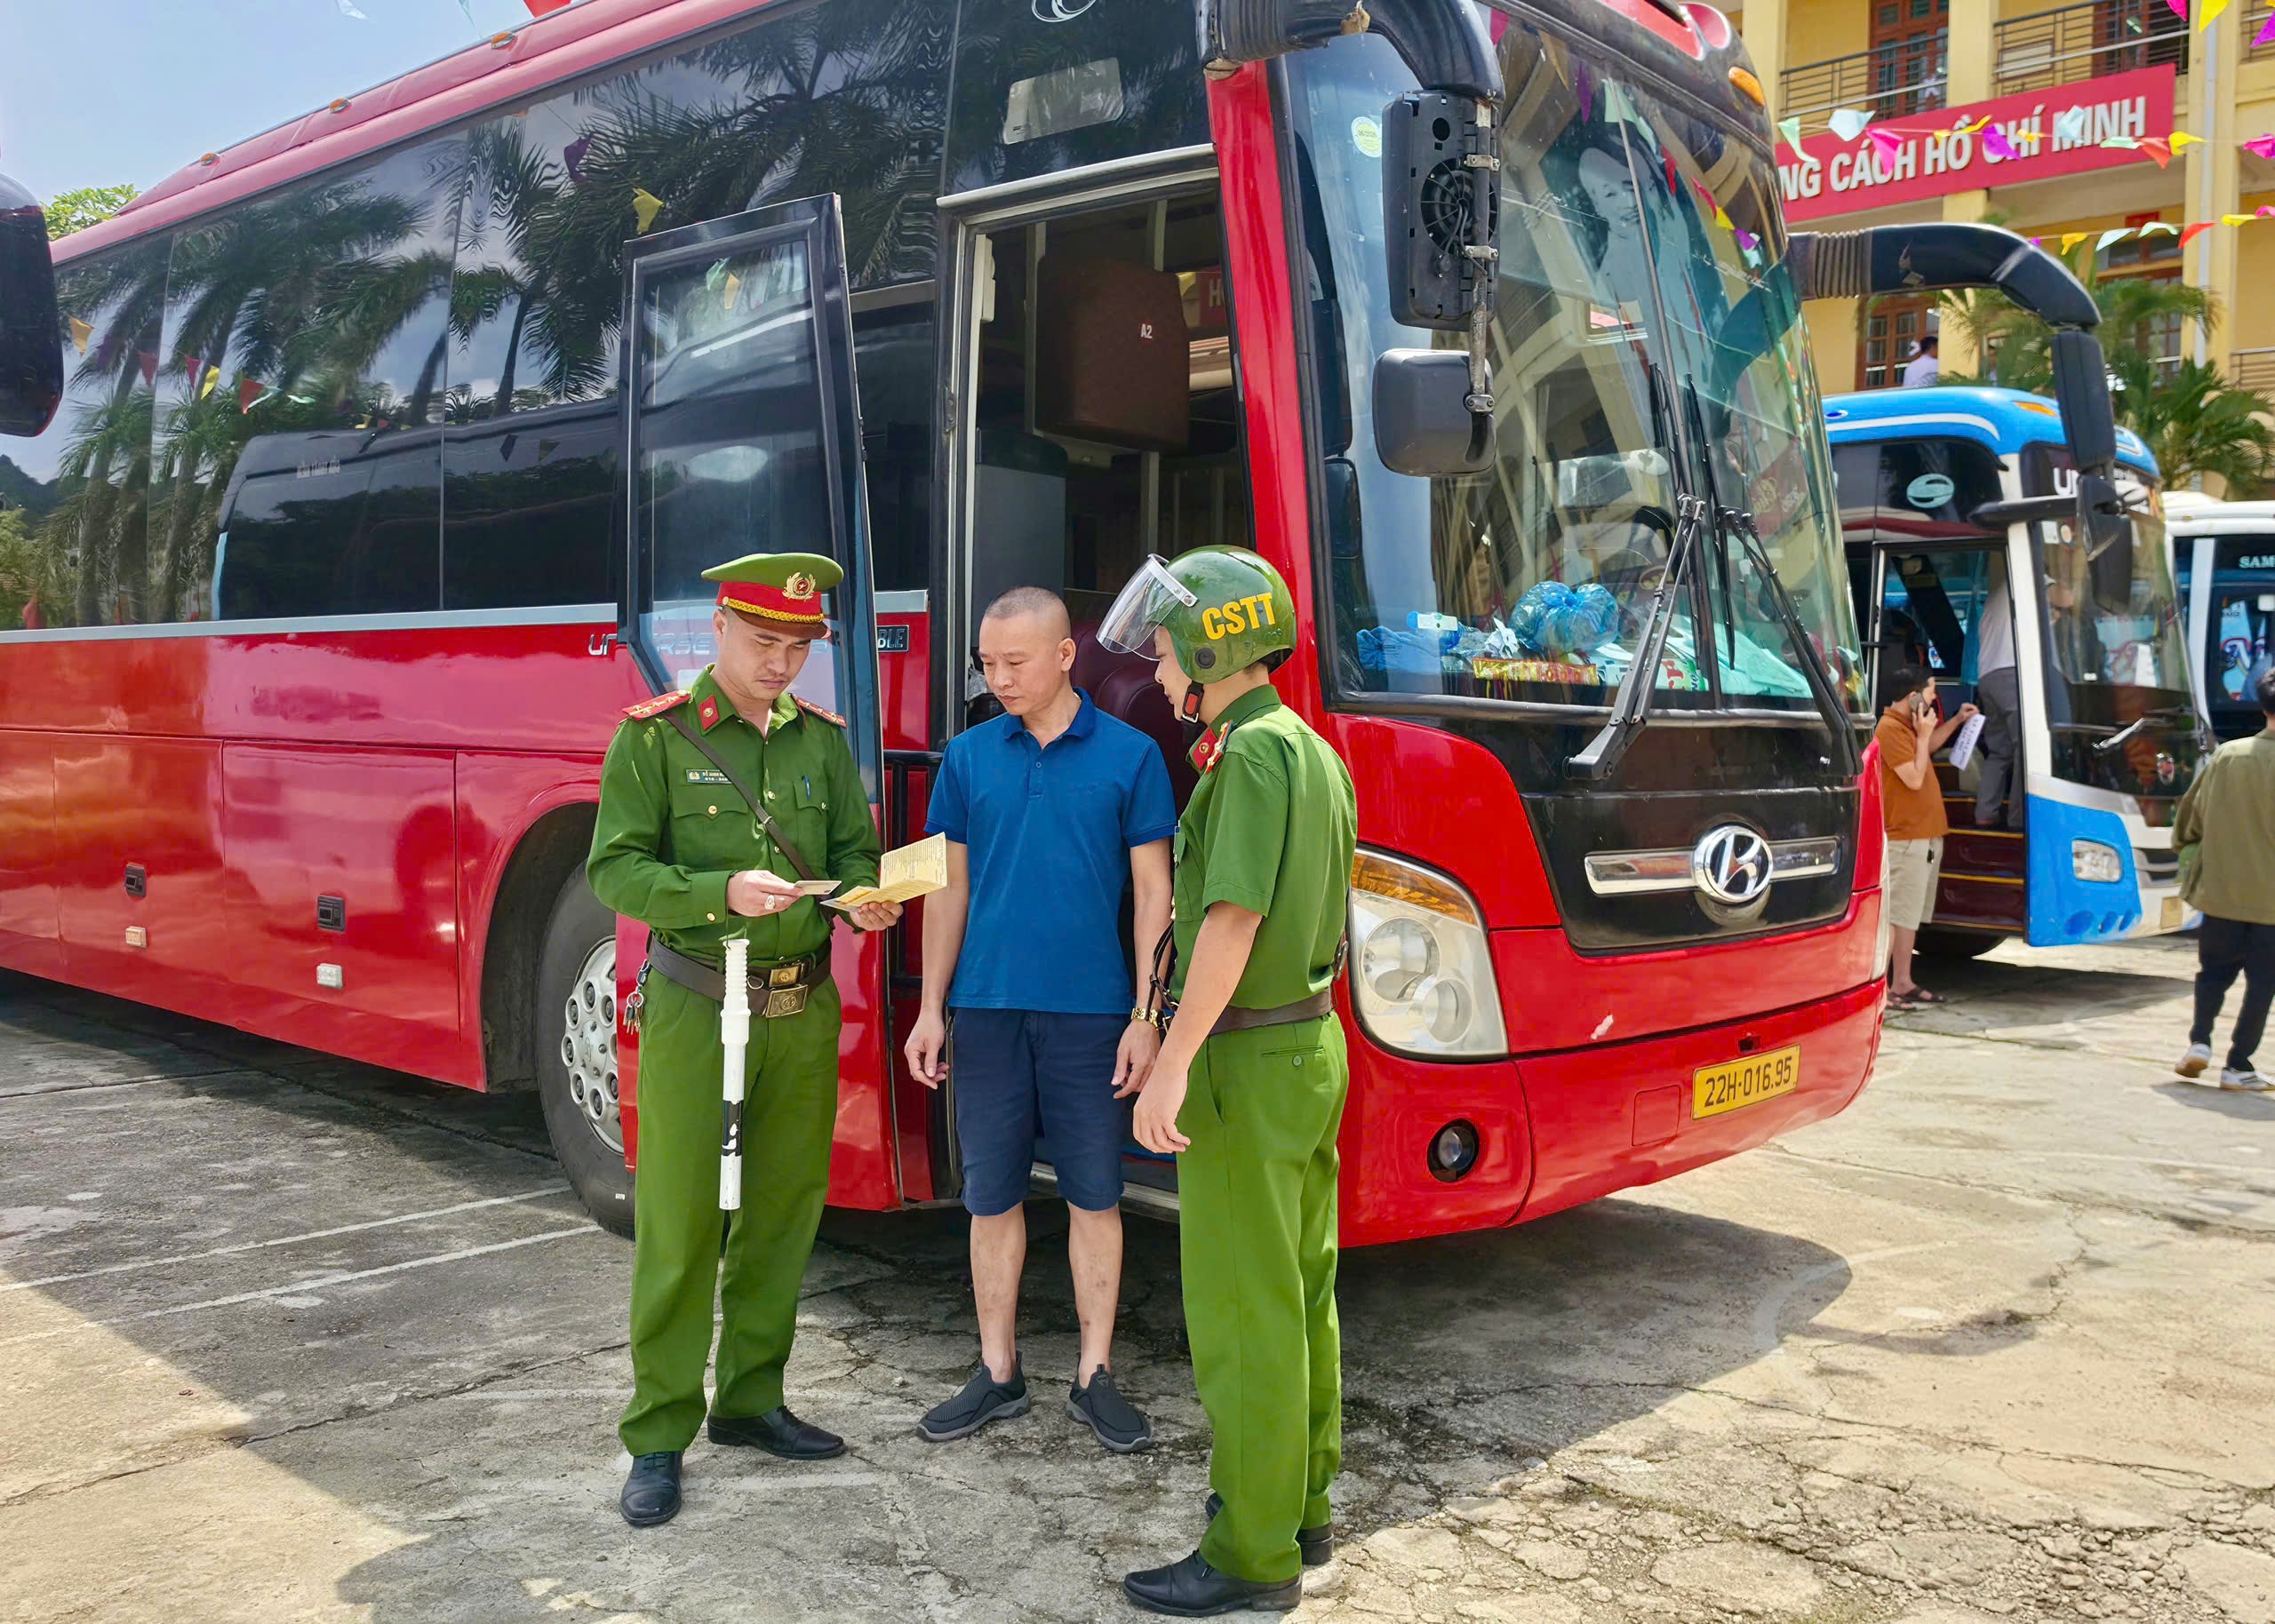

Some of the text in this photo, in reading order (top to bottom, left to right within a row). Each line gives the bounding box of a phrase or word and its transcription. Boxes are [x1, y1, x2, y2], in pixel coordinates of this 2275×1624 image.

[1140, 322, 1153, 339] A2
[1201, 592, 1276, 641] CSTT
[1704, 1056, 1792, 1108] 22H-016.95
